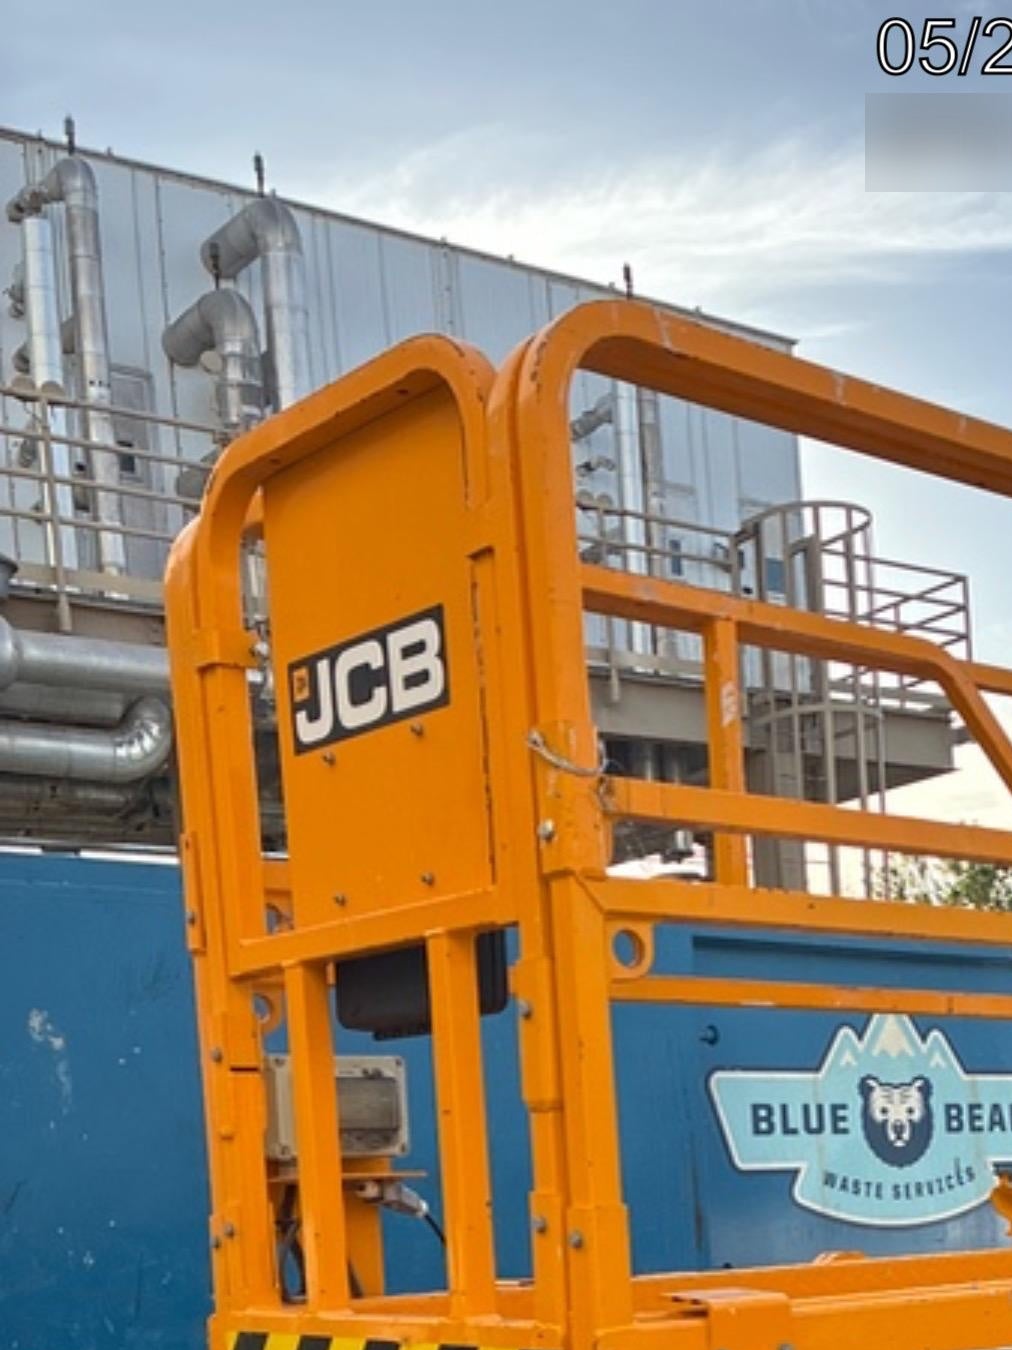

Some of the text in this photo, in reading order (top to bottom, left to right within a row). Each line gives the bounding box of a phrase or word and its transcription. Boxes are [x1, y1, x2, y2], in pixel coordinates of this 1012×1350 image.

[295, 619, 445, 744] JCB
[752, 1103, 850, 1135] BLUE
[823, 1170, 882, 1200] WASTE
